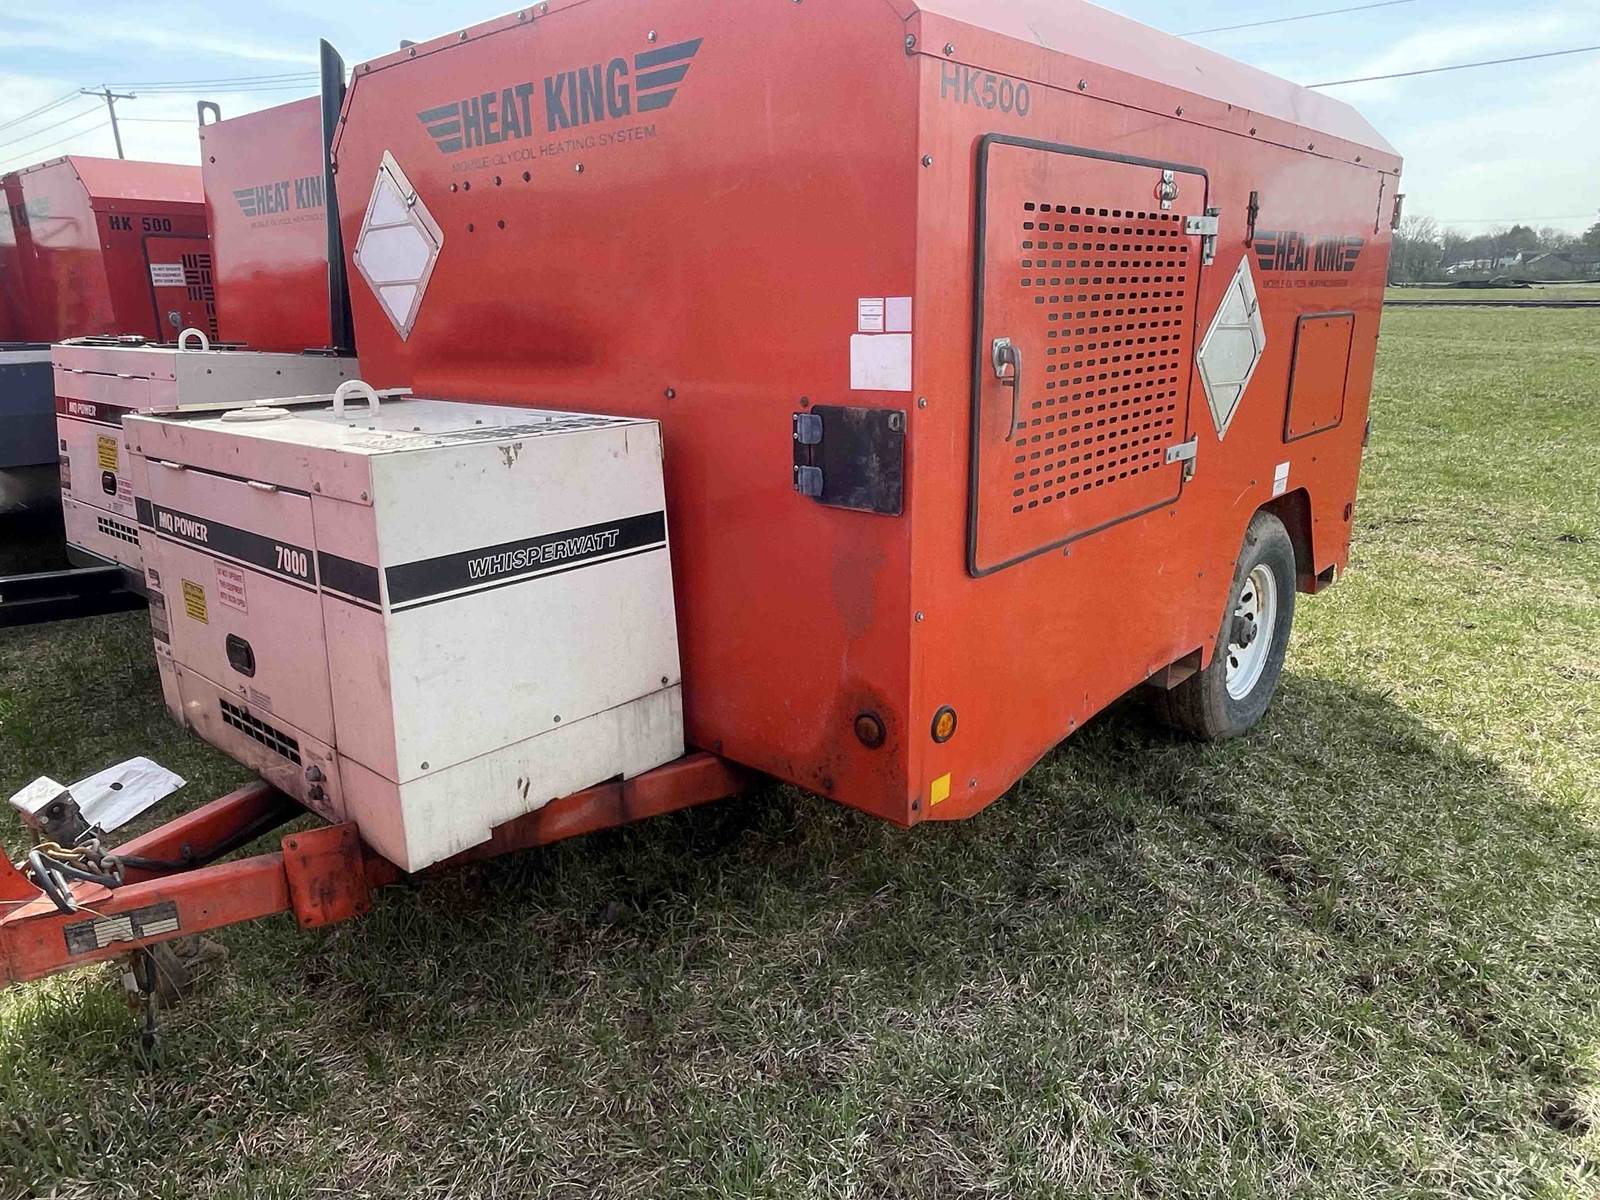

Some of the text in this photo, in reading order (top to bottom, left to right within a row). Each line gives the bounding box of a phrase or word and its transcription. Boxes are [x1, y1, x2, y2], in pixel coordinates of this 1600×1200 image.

[460, 57, 631, 149] HEAT KING
[941, 61, 1030, 117] HK500
[492, 149, 537, 166] GLYCOL
[539, 136, 597, 157] HEATING
[598, 124, 657, 146] SYSTEM
[255, 175, 326, 215] HEAT KIN
[109, 215, 172, 233] HK 500
[1275, 231, 1345, 272] HEAT KING
[77, 403, 97, 417] POWER
[158, 511, 208, 543] MQ POWER
[274, 545, 308, 578] 7000
[467, 528, 620, 579] WHISPERWATT
